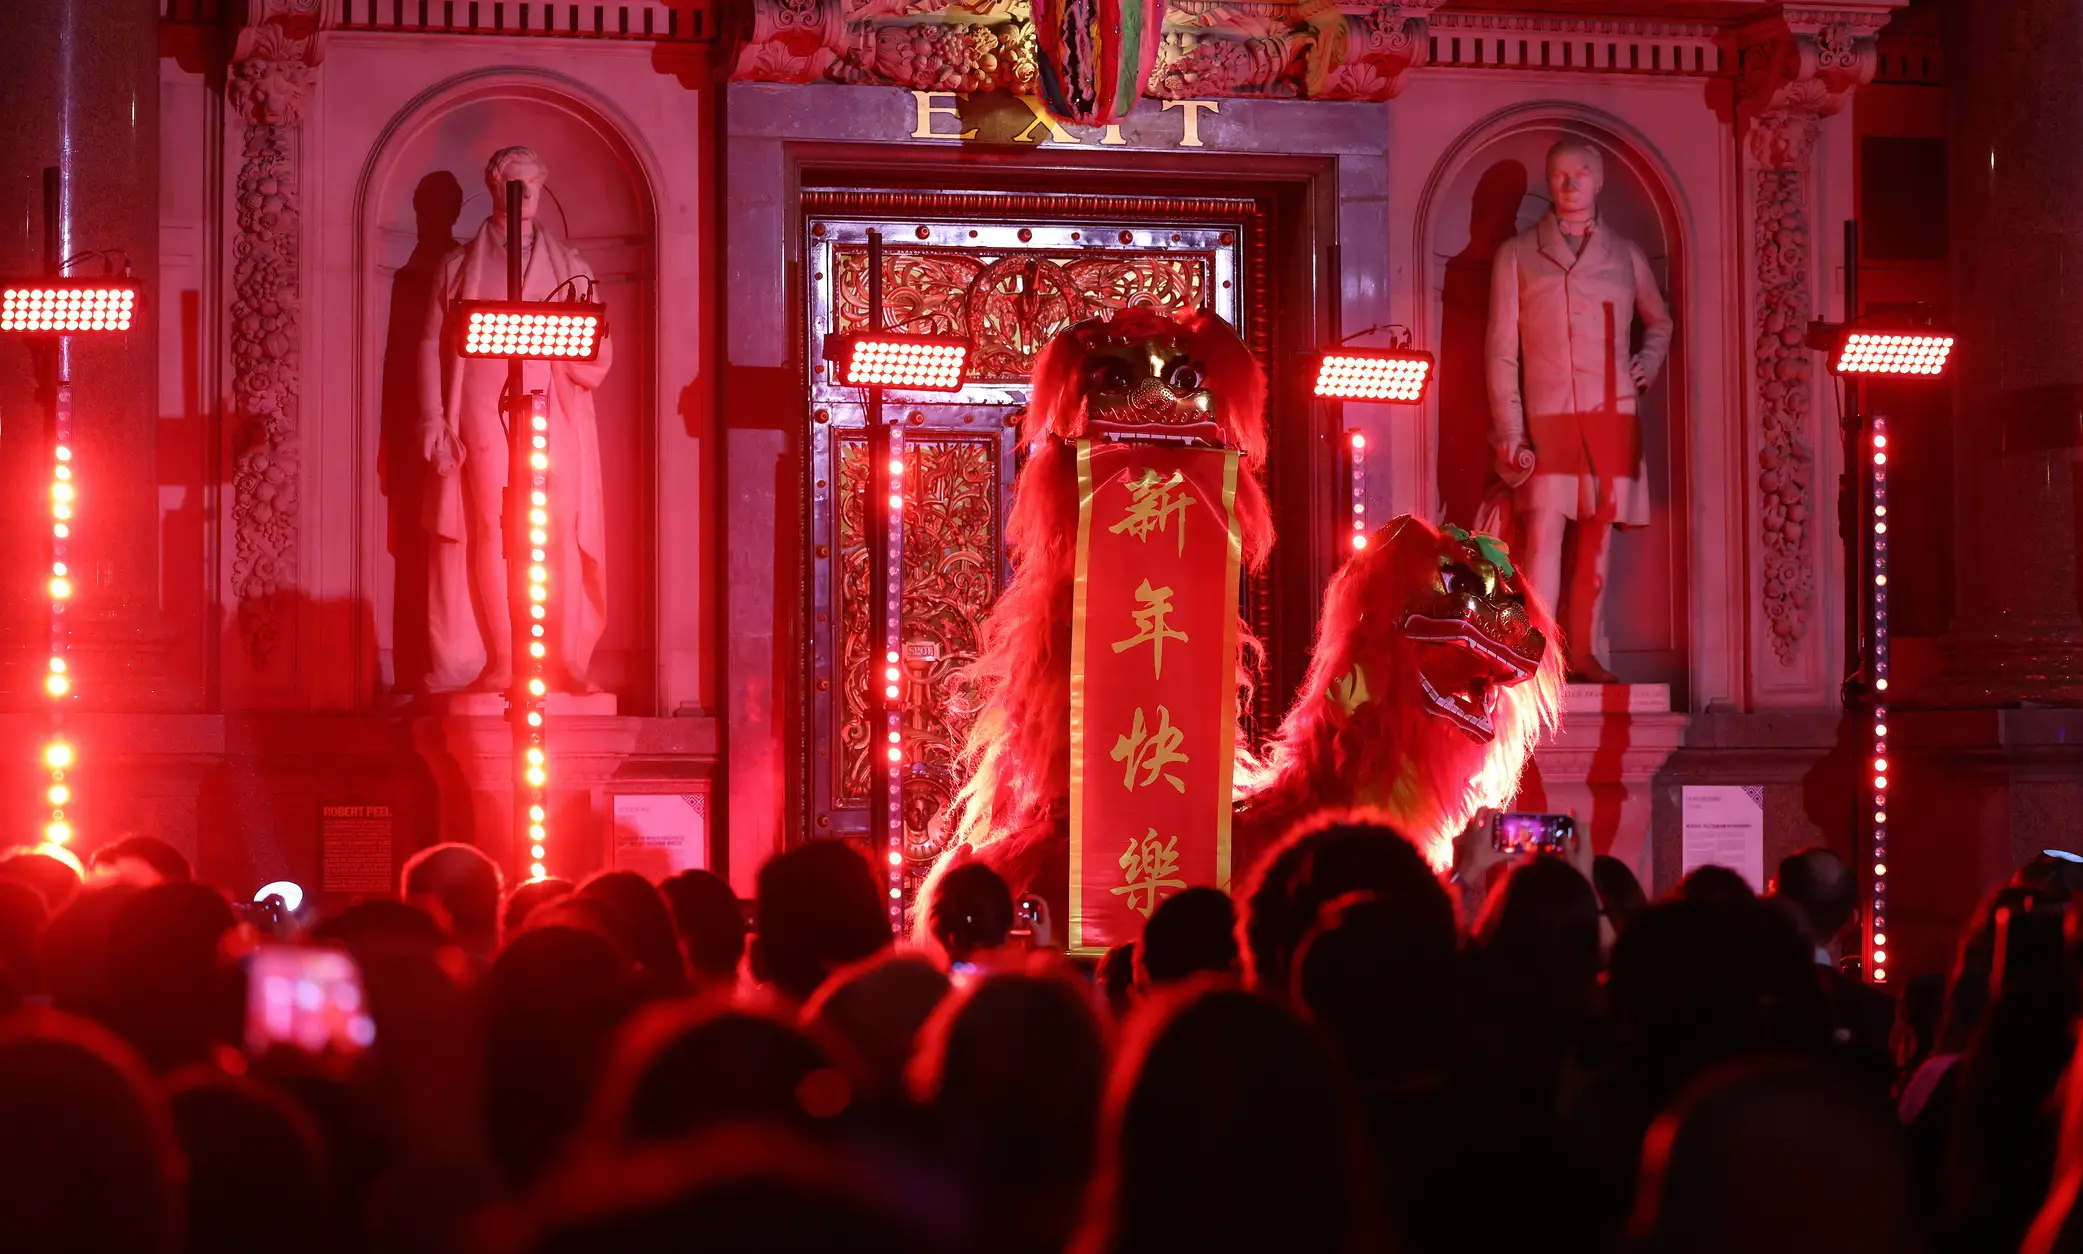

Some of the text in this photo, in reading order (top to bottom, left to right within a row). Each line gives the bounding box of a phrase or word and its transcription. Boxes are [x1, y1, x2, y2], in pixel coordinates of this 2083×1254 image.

[1109, 468, 1196, 919] 新年快樂
[323, 806, 392, 817] ROBERT PEEL
